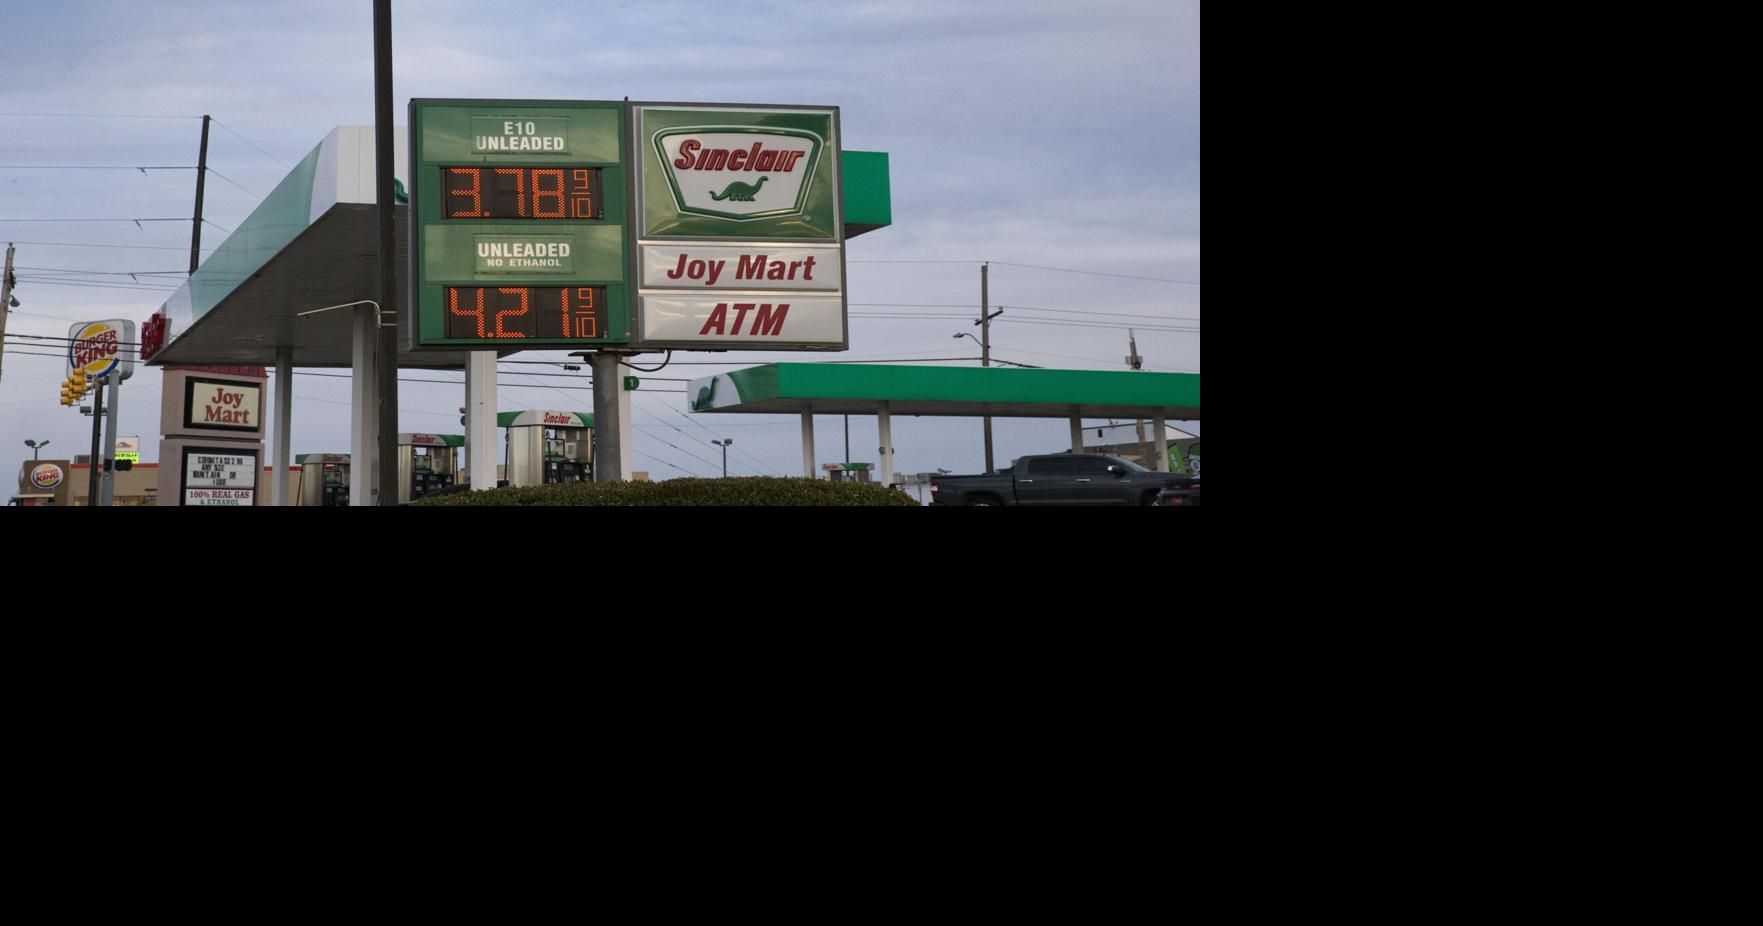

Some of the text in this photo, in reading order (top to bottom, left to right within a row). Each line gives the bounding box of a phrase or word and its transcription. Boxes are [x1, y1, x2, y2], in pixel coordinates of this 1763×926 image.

[504, 122, 536, 135] E10
[476, 136, 565, 150] UNLEADED
[674, 139, 806, 172] Sinclair
[451, 168, 589, 218] 3.78 9
[571, 197, 591, 218] 10
[477, 243, 571, 257] UNLEADED
[487, 258, 562, 267] NO ETHANOL
[666, 253, 816, 286] Joy Mart
[450, 287, 593, 338] 4.21 9
[699, 303, 790, 336] ATM
[575, 317, 596, 338] 10
[75, 329, 117, 355] BURGER
[76, 341, 118, 368] KING
[212, 387, 245, 409] Joy
[204, 405, 250, 424] Mart
[543, 412, 571, 425] Sinclair
[36, 472, 60, 483] KING
[190, 490, 250, 498] 100% REAL GAS
